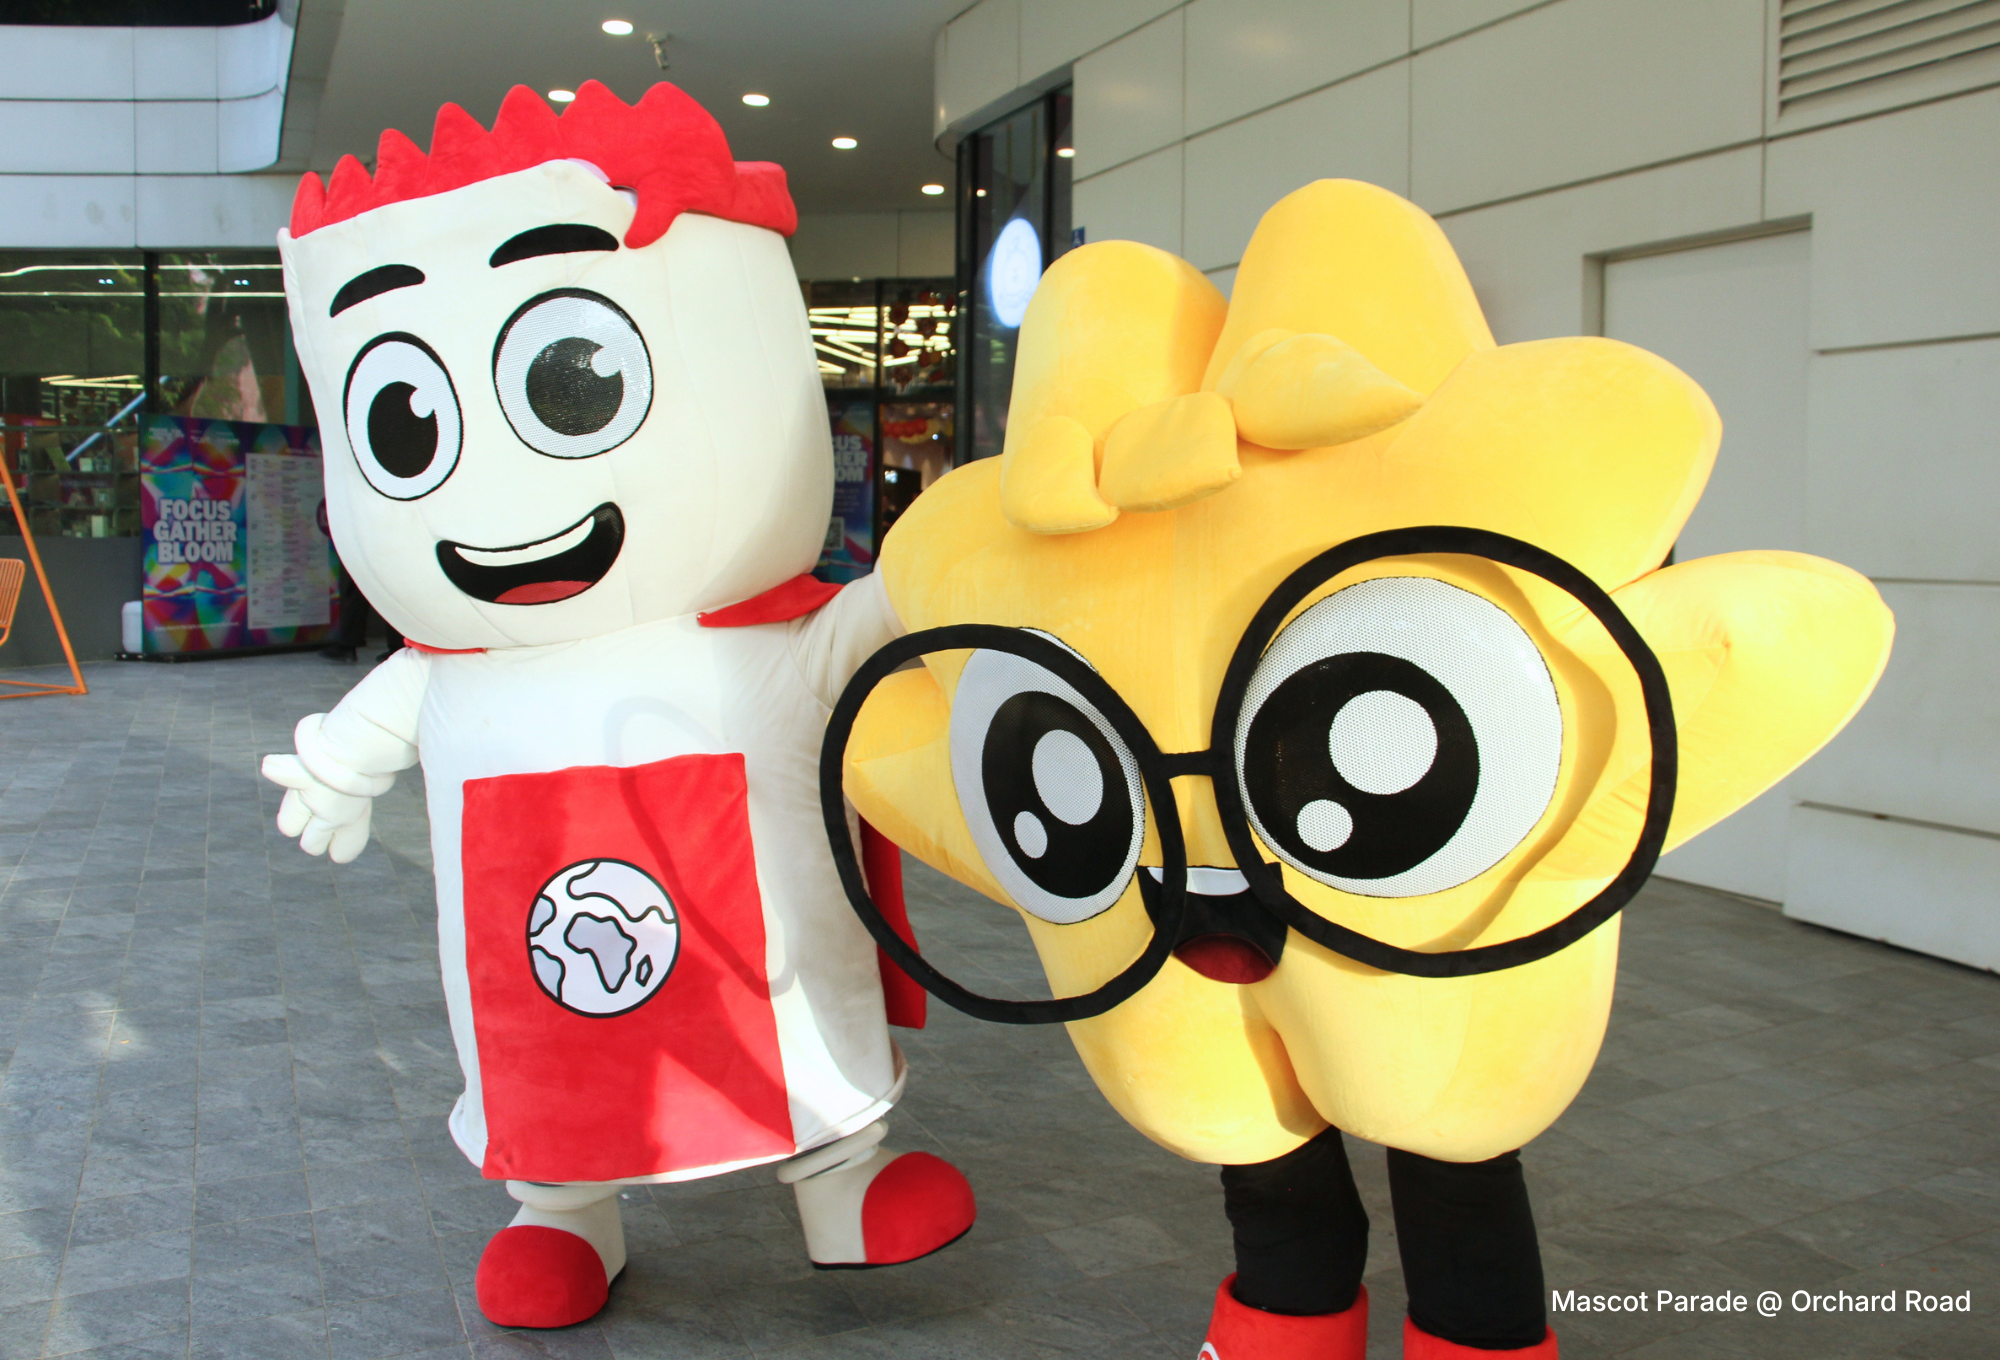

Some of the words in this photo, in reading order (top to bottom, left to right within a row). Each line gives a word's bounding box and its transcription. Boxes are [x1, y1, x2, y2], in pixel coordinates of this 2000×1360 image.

[160, 498, 231, 520] FOCUS
[153, 519, 237, 542] GATHER
[158, 541, 233, 563] BLOOM
